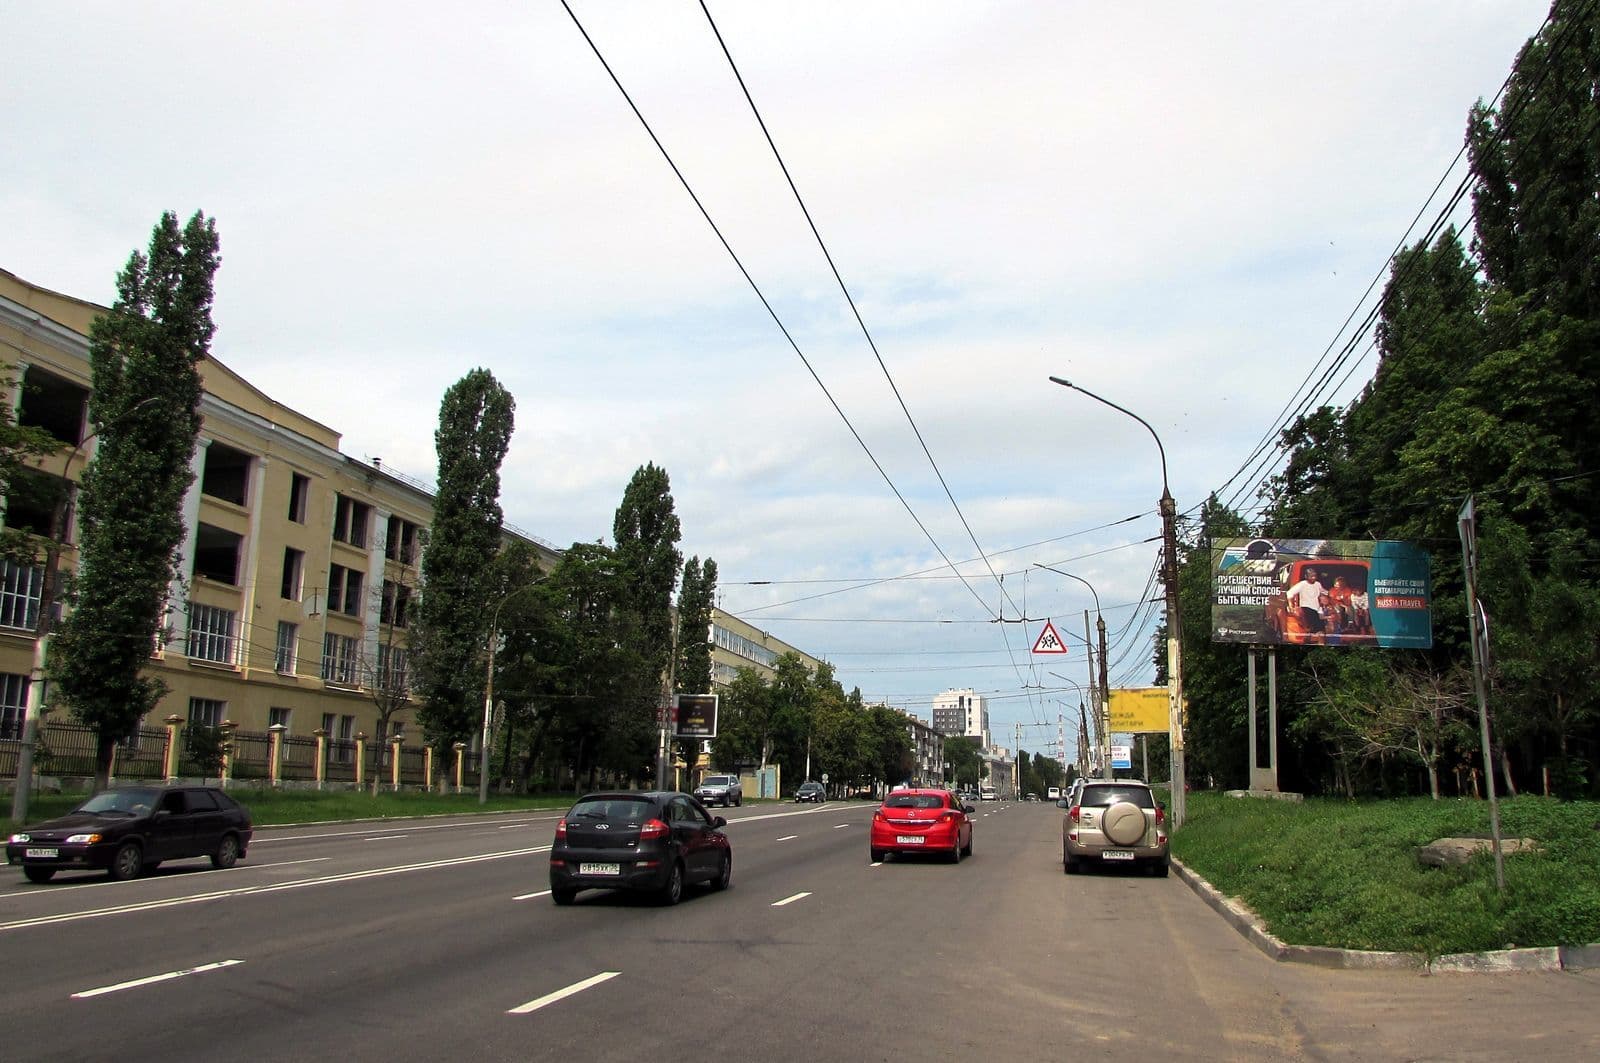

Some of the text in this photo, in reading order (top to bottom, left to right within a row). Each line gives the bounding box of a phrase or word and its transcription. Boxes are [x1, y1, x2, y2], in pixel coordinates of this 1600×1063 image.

[1218, 576, 1272, 584] ПУТЕШЕСТВИЯ
[1218, 585, 1280, 595] ЛУЧШИЙ СПОСОБ
[1218, 596, 1270, 605] БЫТЬ ВМЕСТЕ
